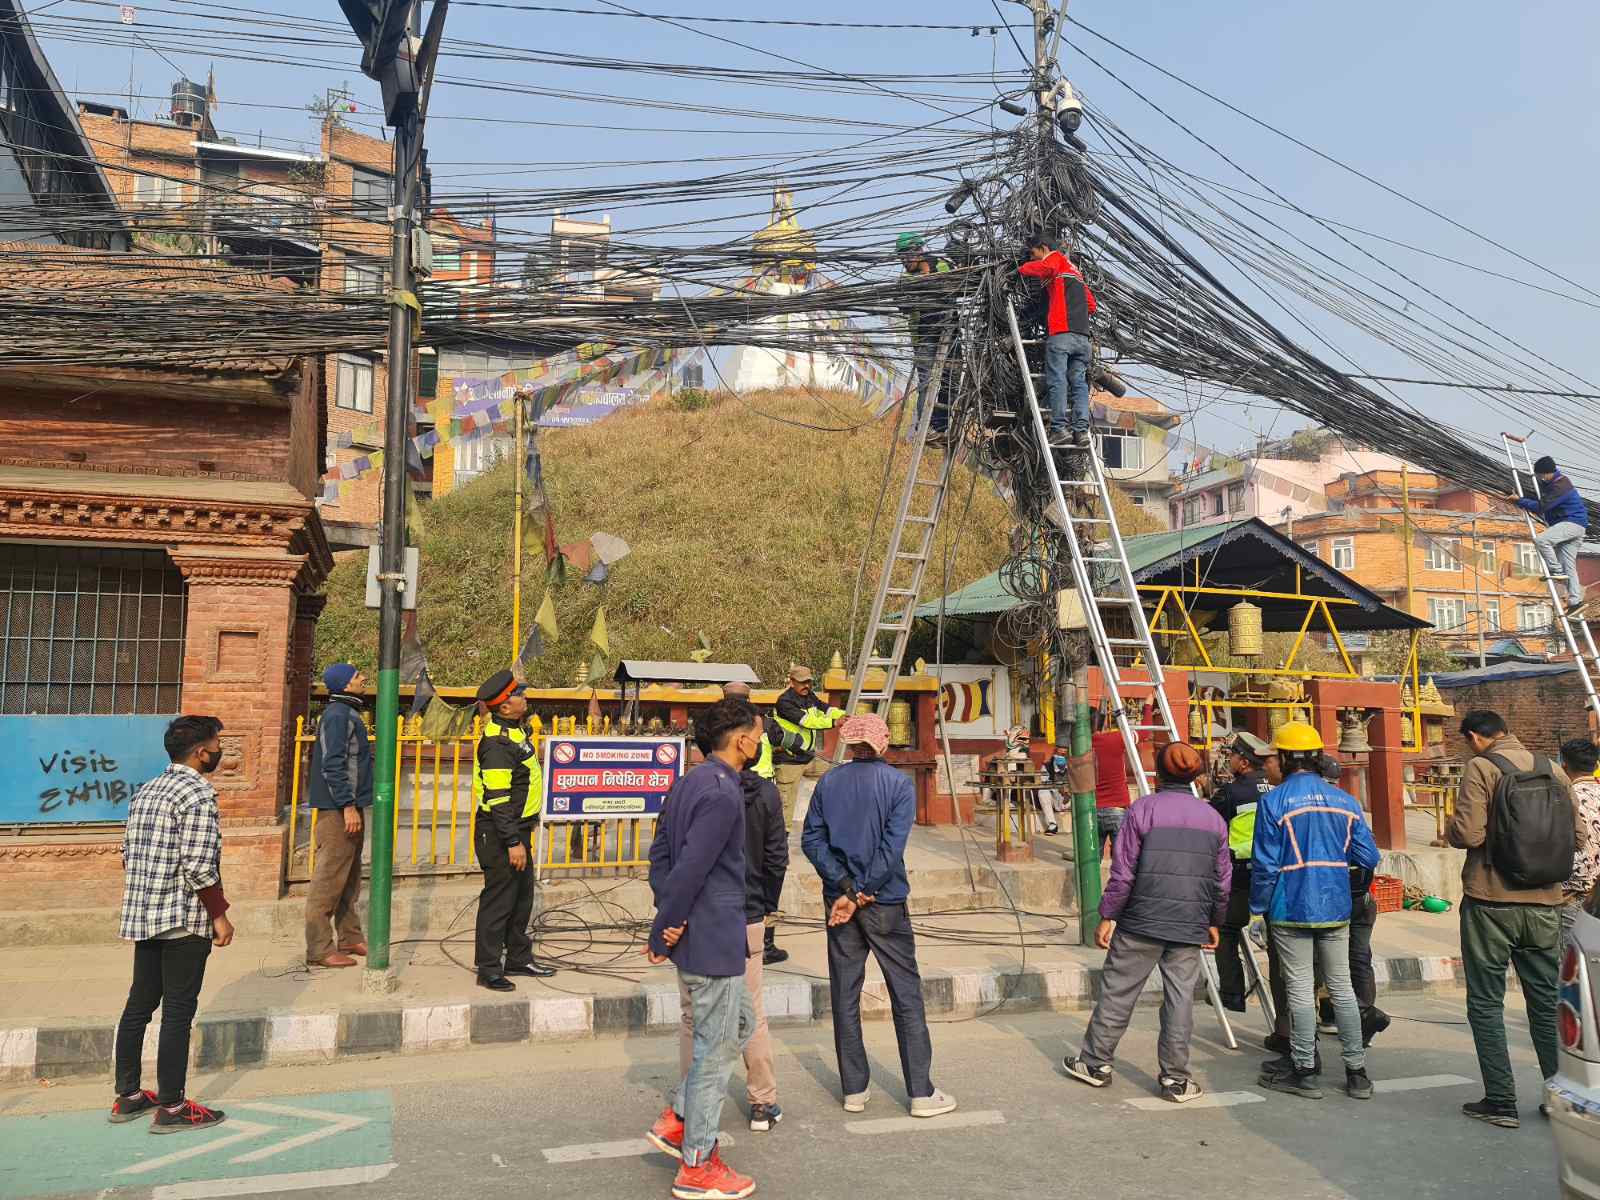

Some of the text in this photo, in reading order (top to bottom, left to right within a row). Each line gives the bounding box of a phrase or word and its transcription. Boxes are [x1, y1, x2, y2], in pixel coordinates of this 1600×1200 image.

[596, 752, 629, 760] SMOKING
[631, 752, 650, 760] ZONE
[39, 779, 146, 813] EXHIBI
